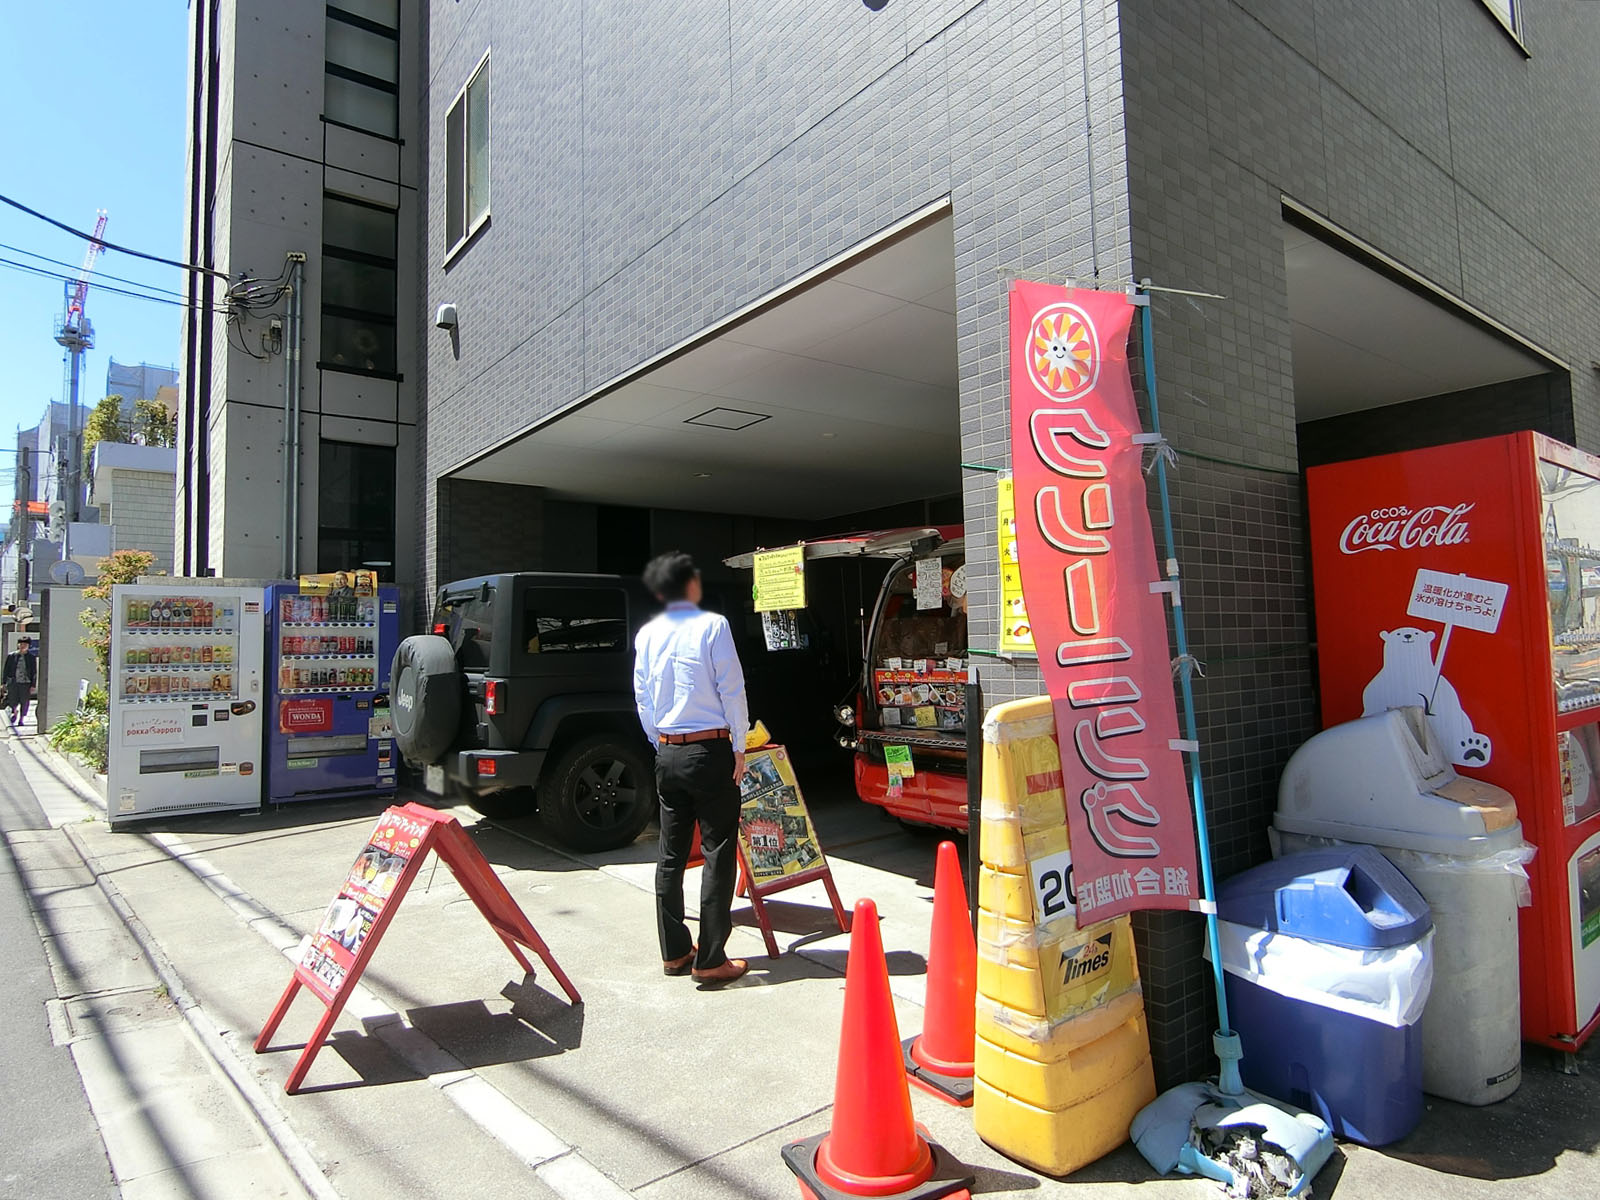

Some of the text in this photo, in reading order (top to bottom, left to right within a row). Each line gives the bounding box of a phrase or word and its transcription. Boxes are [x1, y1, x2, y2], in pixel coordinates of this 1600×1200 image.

[1339, 502, 1476, 554] Coca-Cola
[1422, 583, 1494, 606] 温暖化が進むと
[1060, 949, 1109, 984] Times
